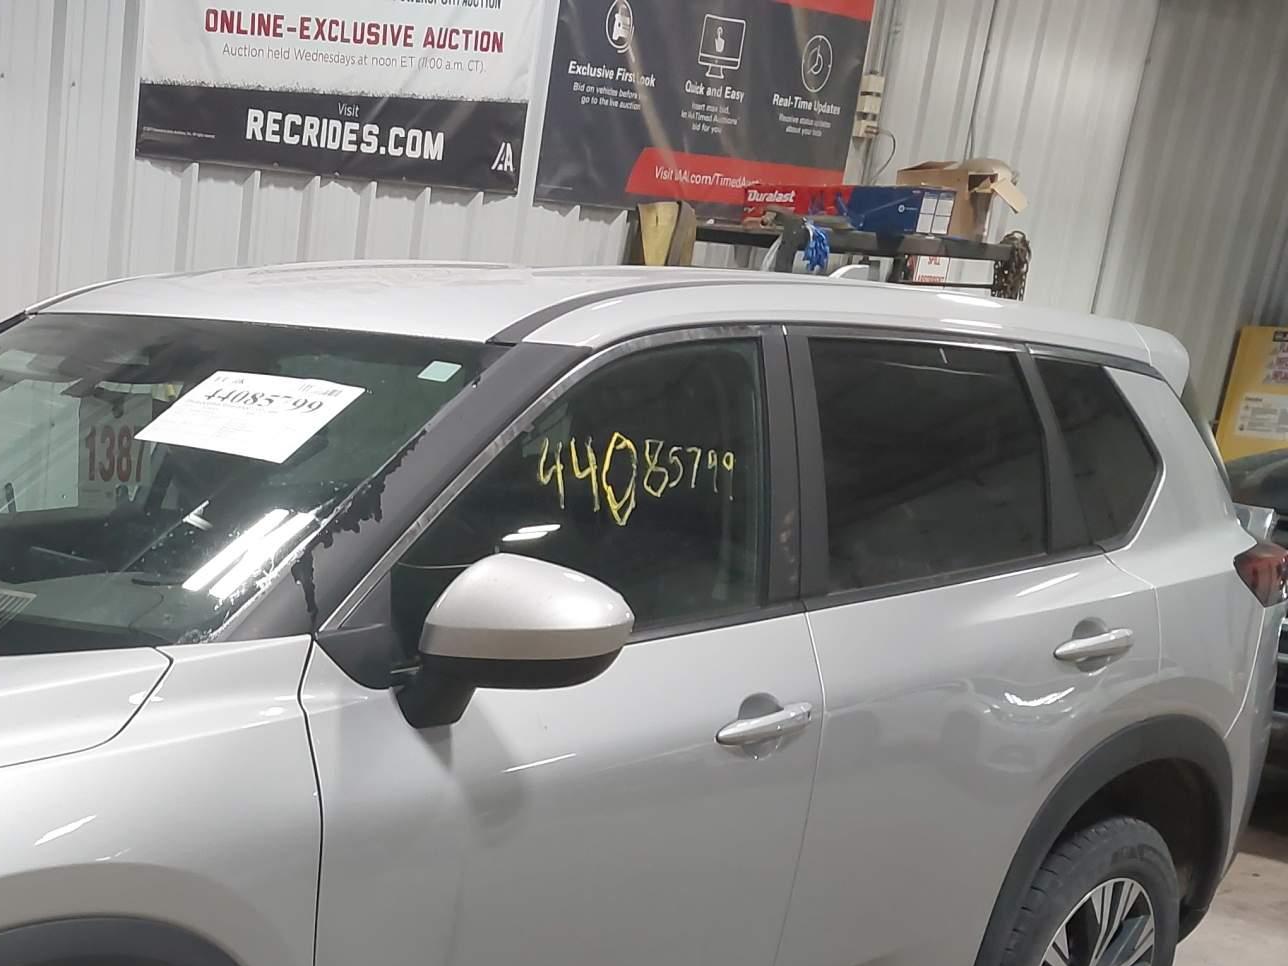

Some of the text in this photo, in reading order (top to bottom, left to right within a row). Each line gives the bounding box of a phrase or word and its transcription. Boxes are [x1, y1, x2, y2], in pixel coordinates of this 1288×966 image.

[204, 8, 504, 53] ONLINE-EXCLUSIVE AUCTION
[222, 42, 265, 58] Auction
[267, 45, 290, 60] held
[293, 47, 356, 67] Wednesdays
[357, 54, 368, 66] at
[371, 56, 397, 68] noon
[400, 56, 416, 69] ET
[567, 60, 615, 81] Exclusive
[637, 72, 656, 87] ook
[685, 79, 745, 103] Quick and Easy
[772, 92, 841, 115] Real-Time Updates
[338, 102, 360, 118] Visit
[245, 108, 445, 161] RECRIDES.COM
[654, 165, 674, 182] Visit
[747, 190, 797, 204] Duralast
[537, 432, 737, 526] 44085799
